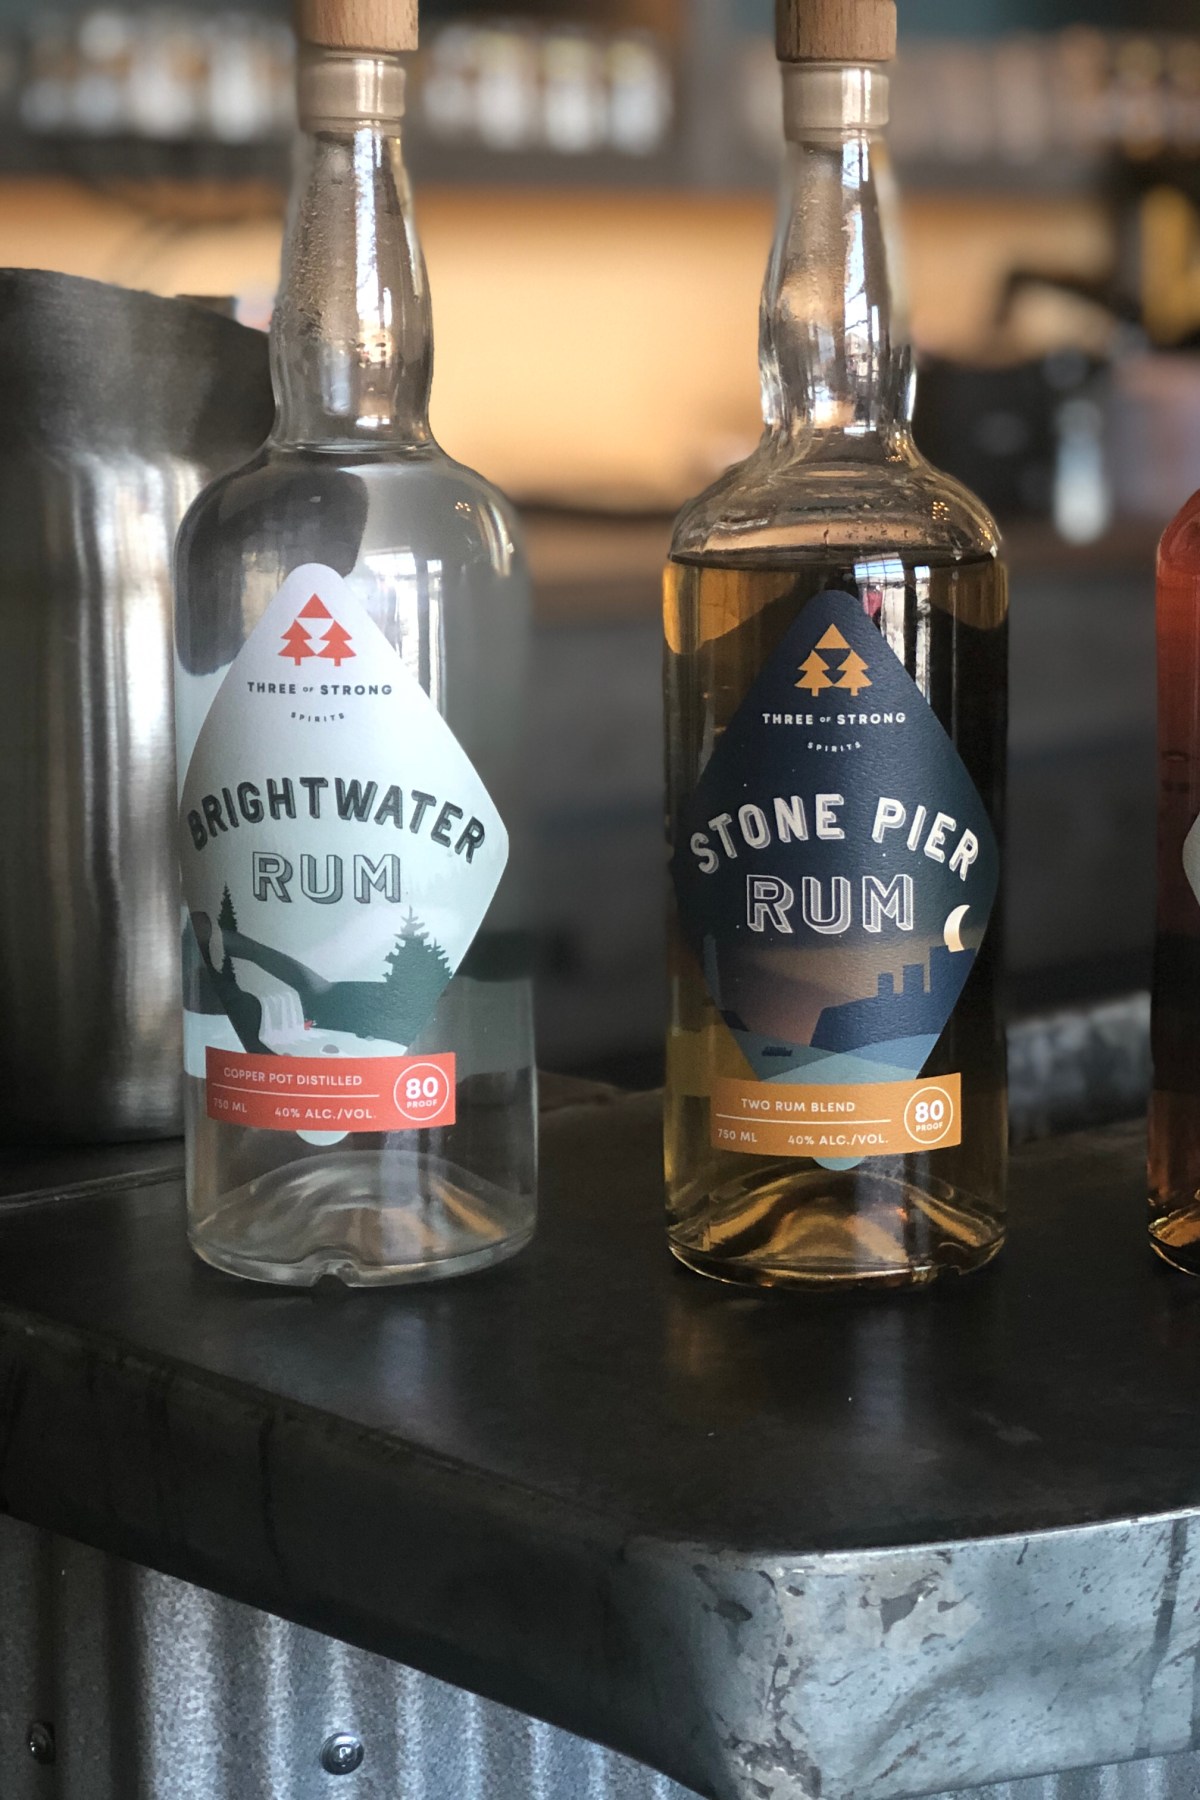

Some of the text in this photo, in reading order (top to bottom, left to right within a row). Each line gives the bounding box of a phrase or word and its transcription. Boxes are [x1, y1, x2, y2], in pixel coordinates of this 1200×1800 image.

[248, 682, 297, 695] THREE
[320, 684, 393, 696] STRONG
[290, 711, 346, 723] SPIRITS
[762, 712, 814, 725] THREE
[837, 712, 906, 725] STRONG
[806, 741, 862, 753] SPIRITS
[187, 777, 485, 863] BRIGHTWATER
[690, 793, 980, 882] STONE PIER
[252, 851, 401, 904] RUM
[746, 874, 914, 935] RUM
[223, 1067, 362, 1086] COPPER POT DISTILLED
[405, 1076, 439, 1100] 80
[213, 1097, 229, 1110] 750
[231, 1101, 248, 1113] ML
[275, 1107, 300, 1118] 40%
[406, 1098, 438, 1109] PROOF
[740, 1098, 856, 1112] TWO RUM BLEND
[914, 1099, 944, 1123] 80
[717, 1128, 736, 1140] 750
[740, 1131, 758, 1143] ML
[788, 1134, 815, 1145] 40%
[915, 1122, 943, 1133] PROOF
